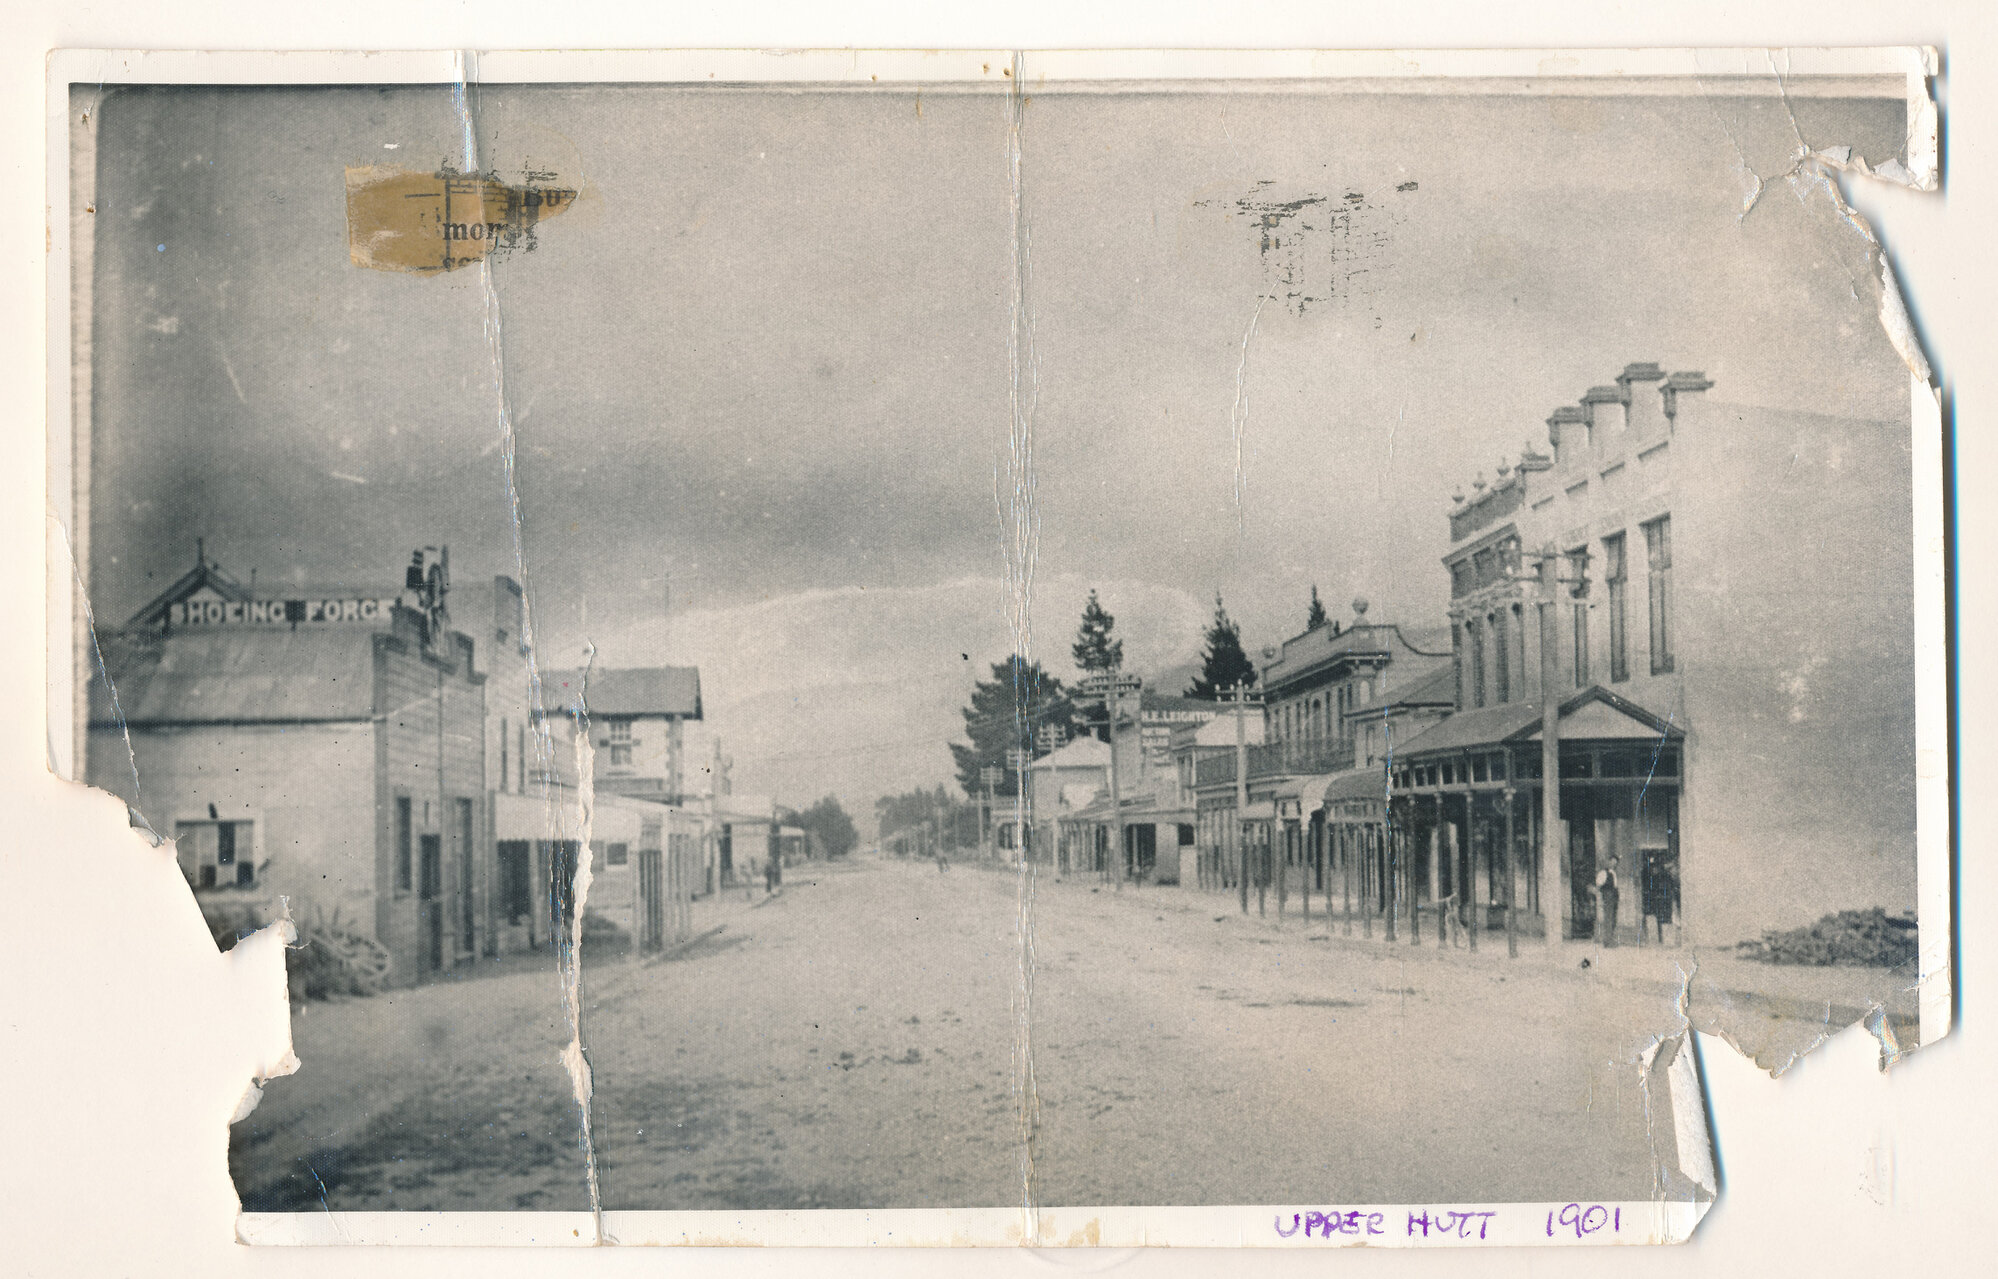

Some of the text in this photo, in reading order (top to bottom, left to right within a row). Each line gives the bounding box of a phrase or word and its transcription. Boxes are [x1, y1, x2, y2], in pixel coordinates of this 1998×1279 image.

[169, 599, 395, 624] SHOEING FORGE
[1274, 1203, 1621, 1240] UPPER HUTT 1901
